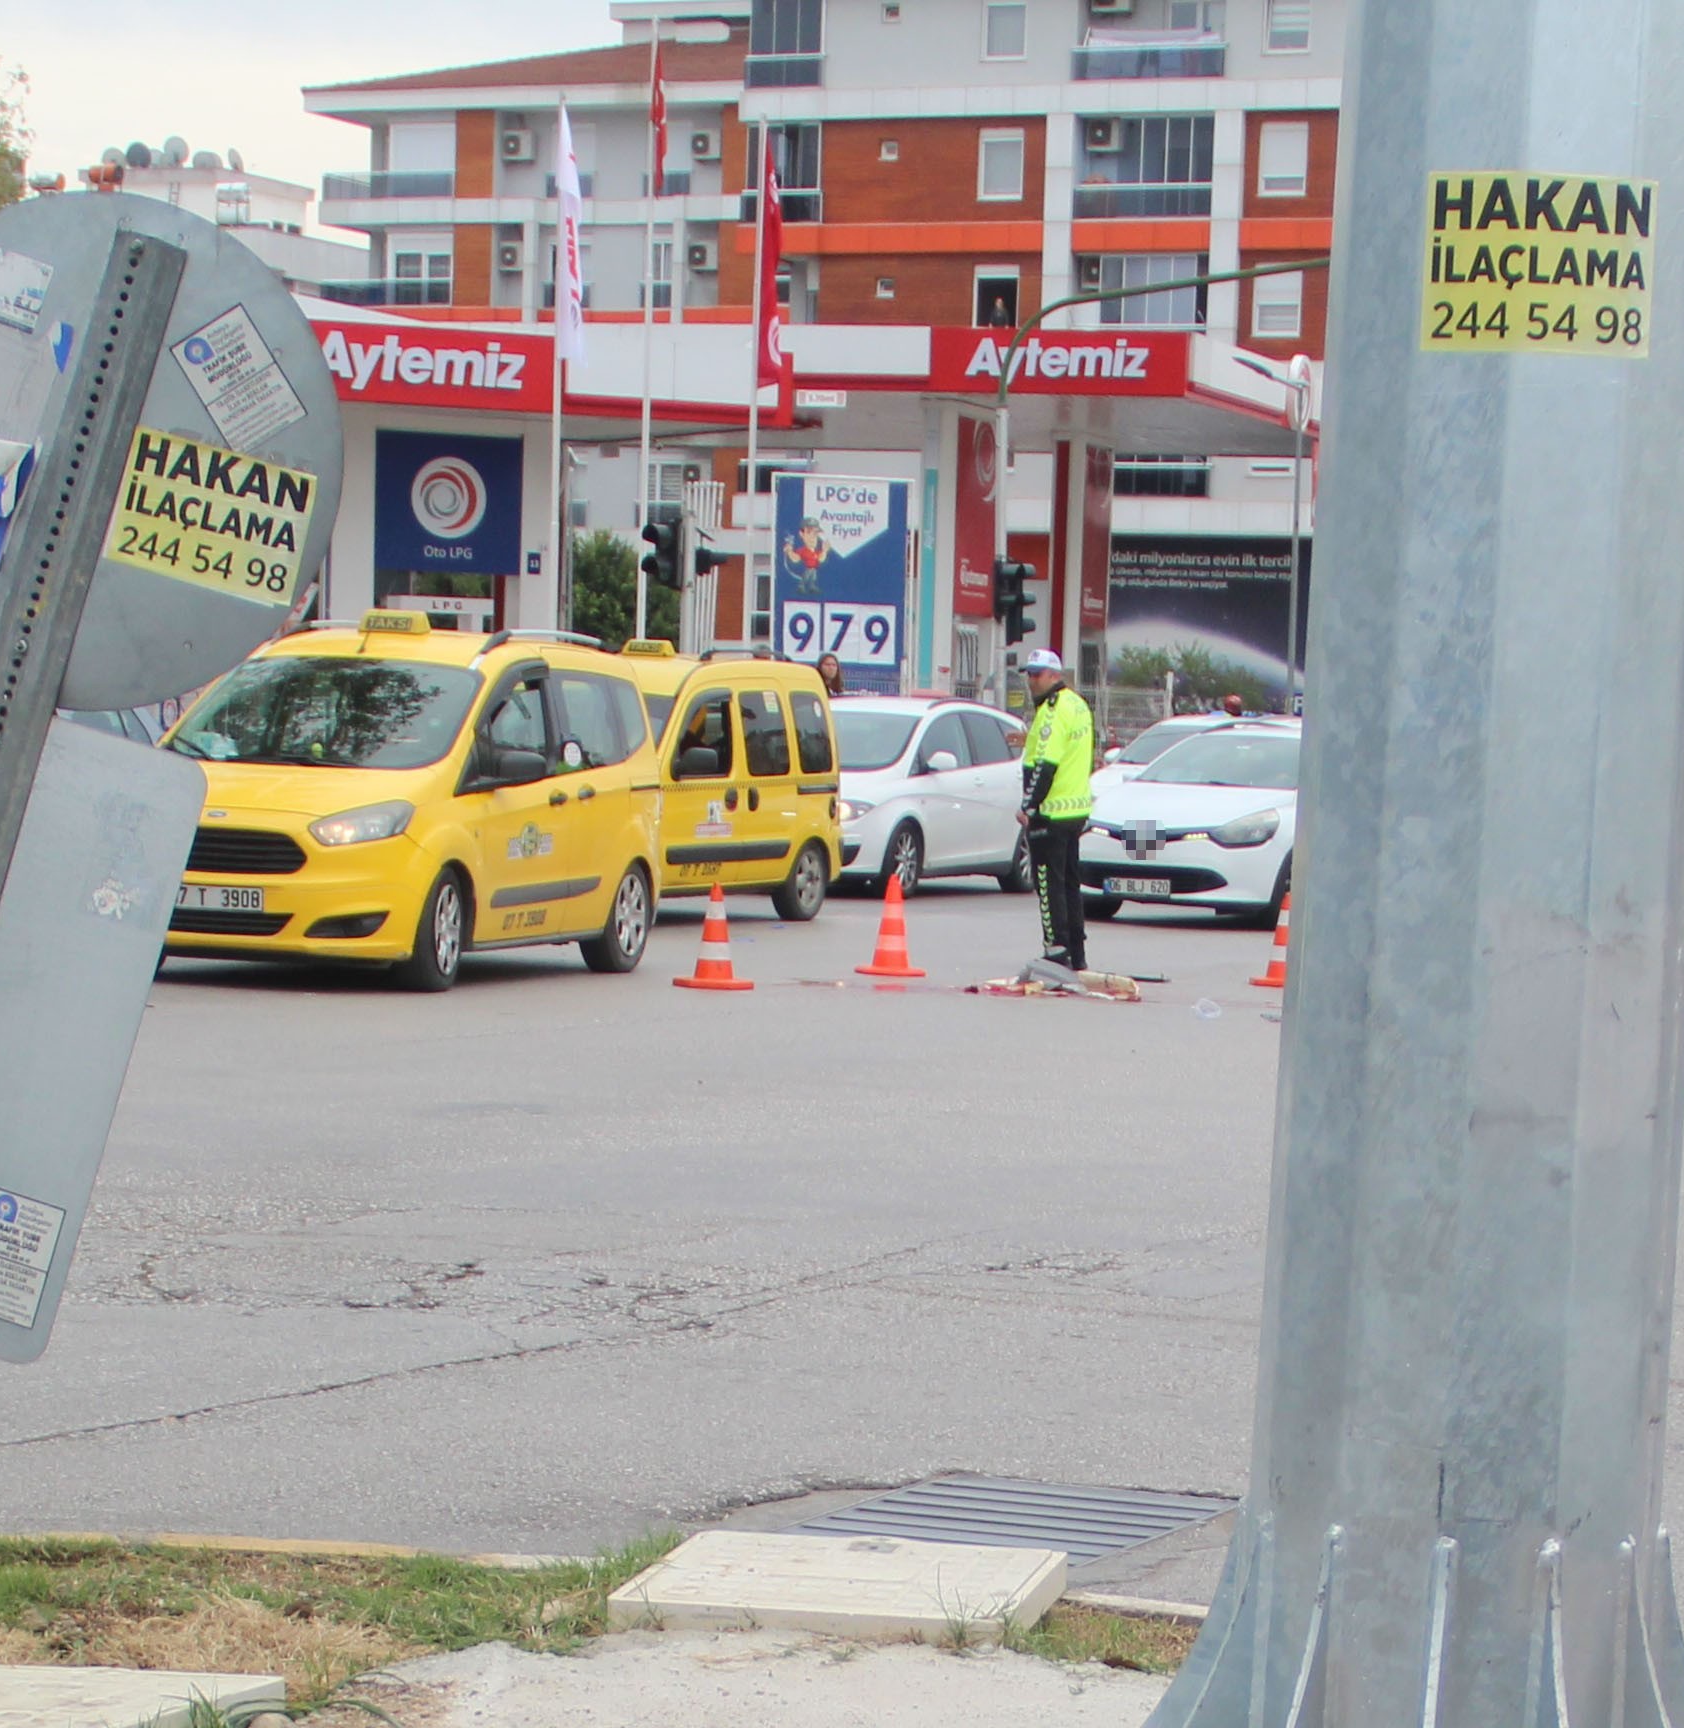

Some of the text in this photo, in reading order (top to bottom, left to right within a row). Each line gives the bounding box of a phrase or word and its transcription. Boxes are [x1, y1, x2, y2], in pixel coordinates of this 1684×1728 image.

[1434, 178, 1651, 237] HAKAN
[1431, 236, 1645, 290] İLAÇLAMA
[1431, 301, 1641, 345] 244 54 98
[322, 330, 526, 390] Aytemiz
[964, 337, 1149, 386] Aytemiz
[134, 433, 310, 513] HAKAN
[816, 486, 878, 505] LPG'de
[125, 475, 295, 552] İLAÇLAMA
[820, 510, 875, 524] Avantajlı
[832, 525, 862, 539] Fiyat
[118, 526, 288, 592] 244 54 98
[424, 545, 473, 560] Oto LPG
[1139, 552, 1211, 567] milyonlarca
[1213, 555, 1240, 567] evin
[1241, 554, 1257, 567] ilk
[198, 888, 207, 905] T
[221, 889, 260, 908] 3908
